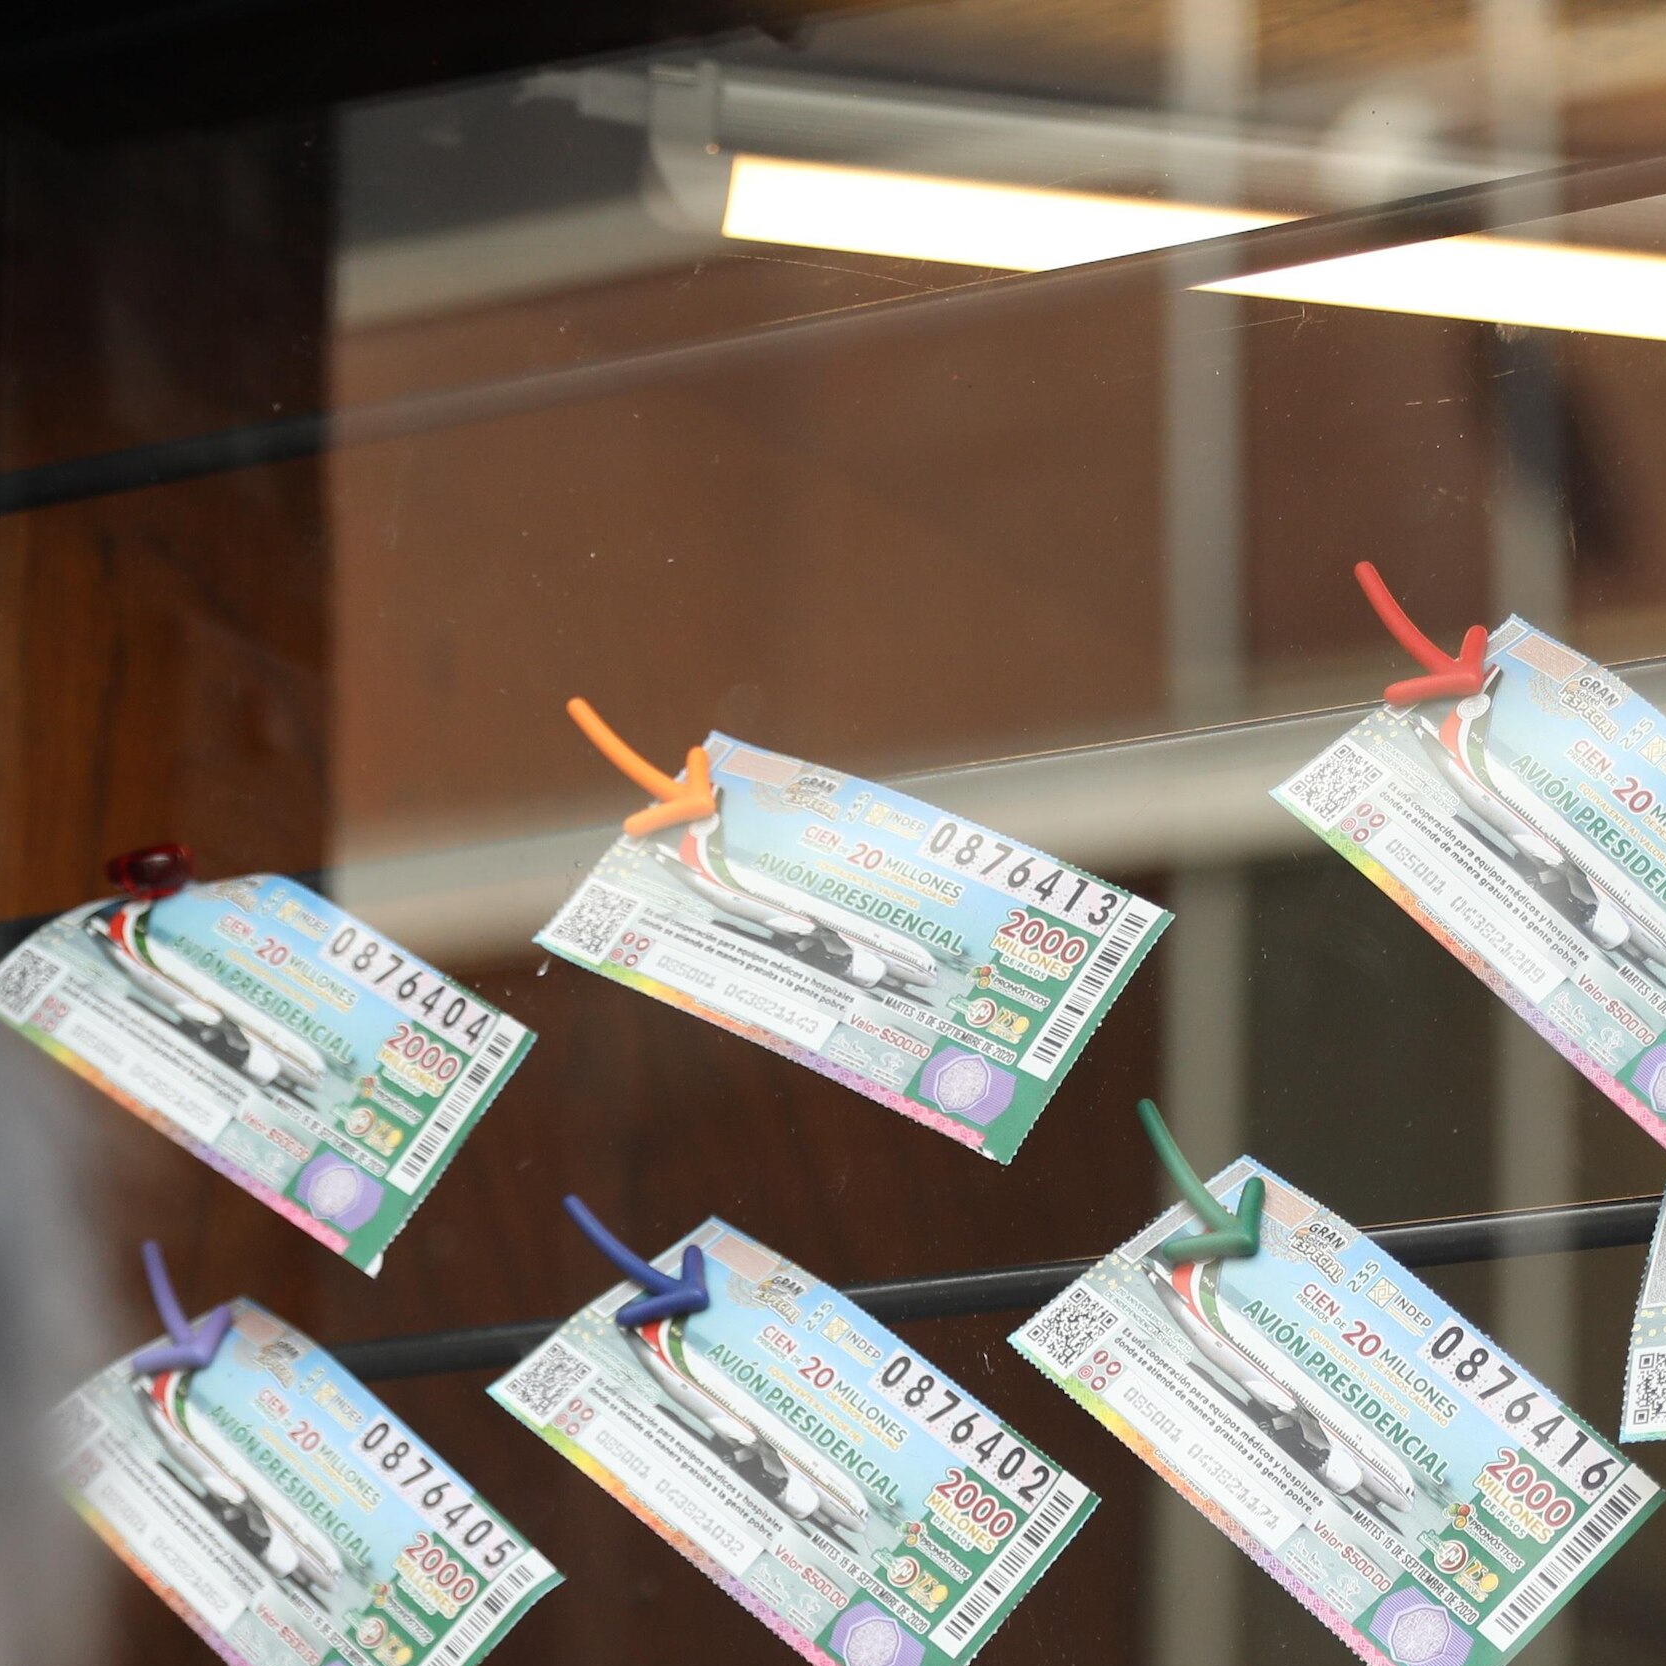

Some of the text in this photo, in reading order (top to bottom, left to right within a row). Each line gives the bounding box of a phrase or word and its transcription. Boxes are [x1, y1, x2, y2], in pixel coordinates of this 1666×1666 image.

[1510, 753, 1580, 812] AVIÓN
[1572, 737, 1614, 775] CIEN
[1612, 776, 1653, 813] 20
[803, 823, 963, 899] CIEN 20 MILLONES
[928, 821, 1119, 926] 0876413
[751, 851, 962, 955] AVIÓN PRESIDENCIAL
[999, 910, 1087, 965] 2000
[328, 925, 492, 1046] 0876404
[991, 936, 1073, 981] MILLONES
[385, 1023, 460, 1083] 2000
[760, 1322, 907, 1443] CIEN 20 MILLONES
[1301, 1281, 1458, 1419] CIEN 20 MILLONES
[704, 1341, 899, 1505] AVIÓN PRESIDENCIAL
[880, 1355, 1050, 1503] 0876402
[1241, 1298, 1448, 1484] AVIÓN PRESIDENCIAL
[1430, 1325, 1616, 1491] 0876416
[361, 1421, 516, 1567] 0876405
[924, 1493, 998, 1555] MILLONES
[935, 1468, 1015, 1539] 2000
[1475, 1474, 1554, 1544] MILLONES
[1487, 1449, 1572, 1528] 2000
[404, 1533, 475, 1604] 2000
